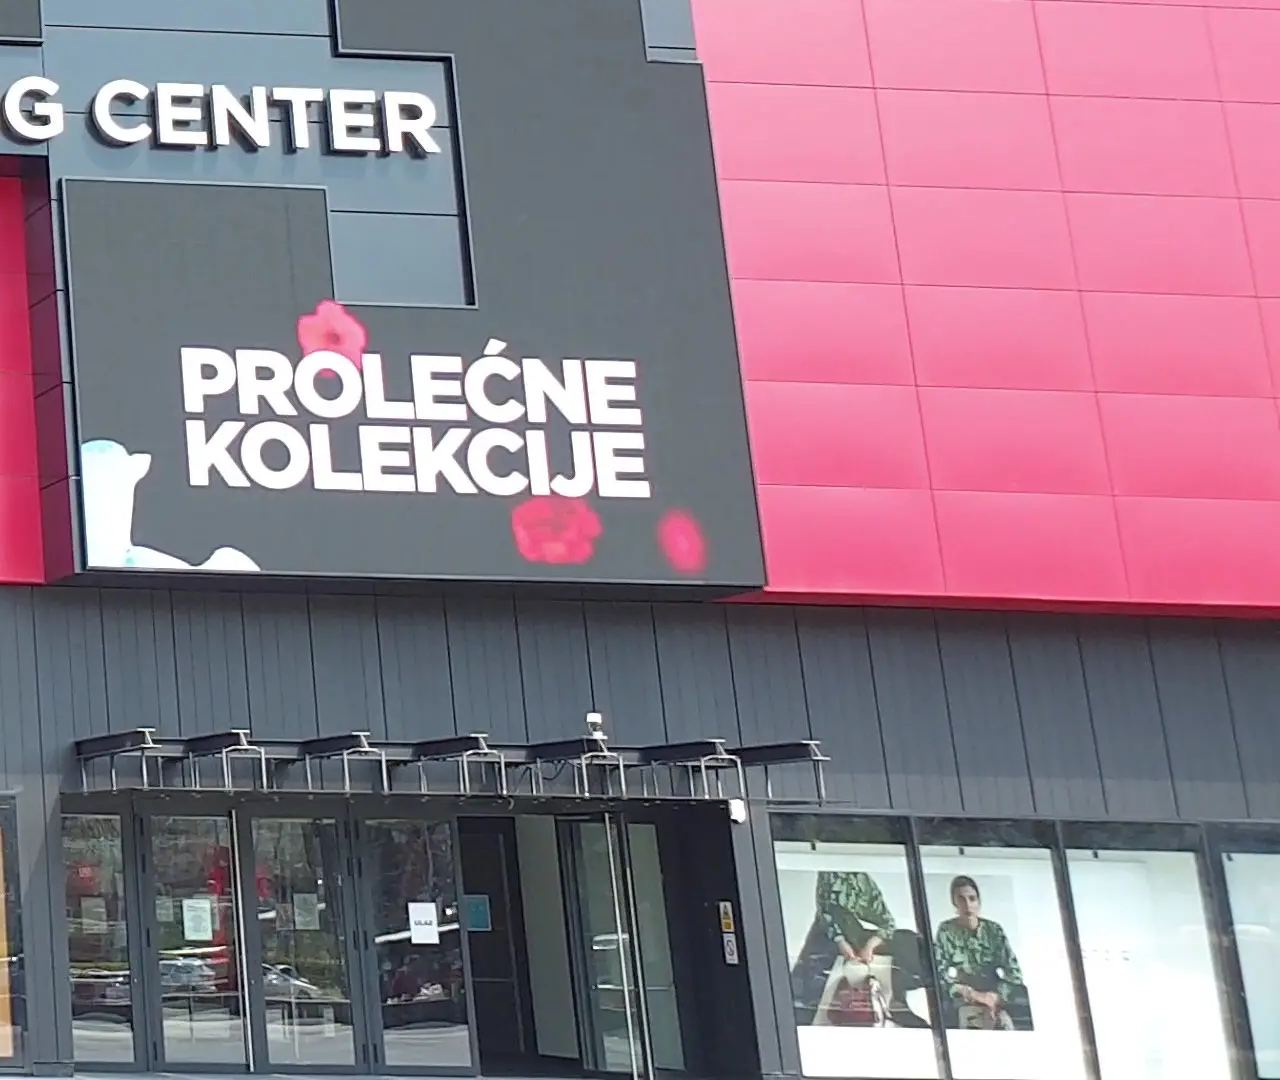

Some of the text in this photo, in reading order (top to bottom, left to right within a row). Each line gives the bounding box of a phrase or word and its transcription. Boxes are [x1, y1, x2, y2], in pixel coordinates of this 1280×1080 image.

[94, 79, 442, 153] CENTER
[180, 338, 642, 426] PROLEĆNE
[185, 420, 651, 498] KOLEKCIJE
